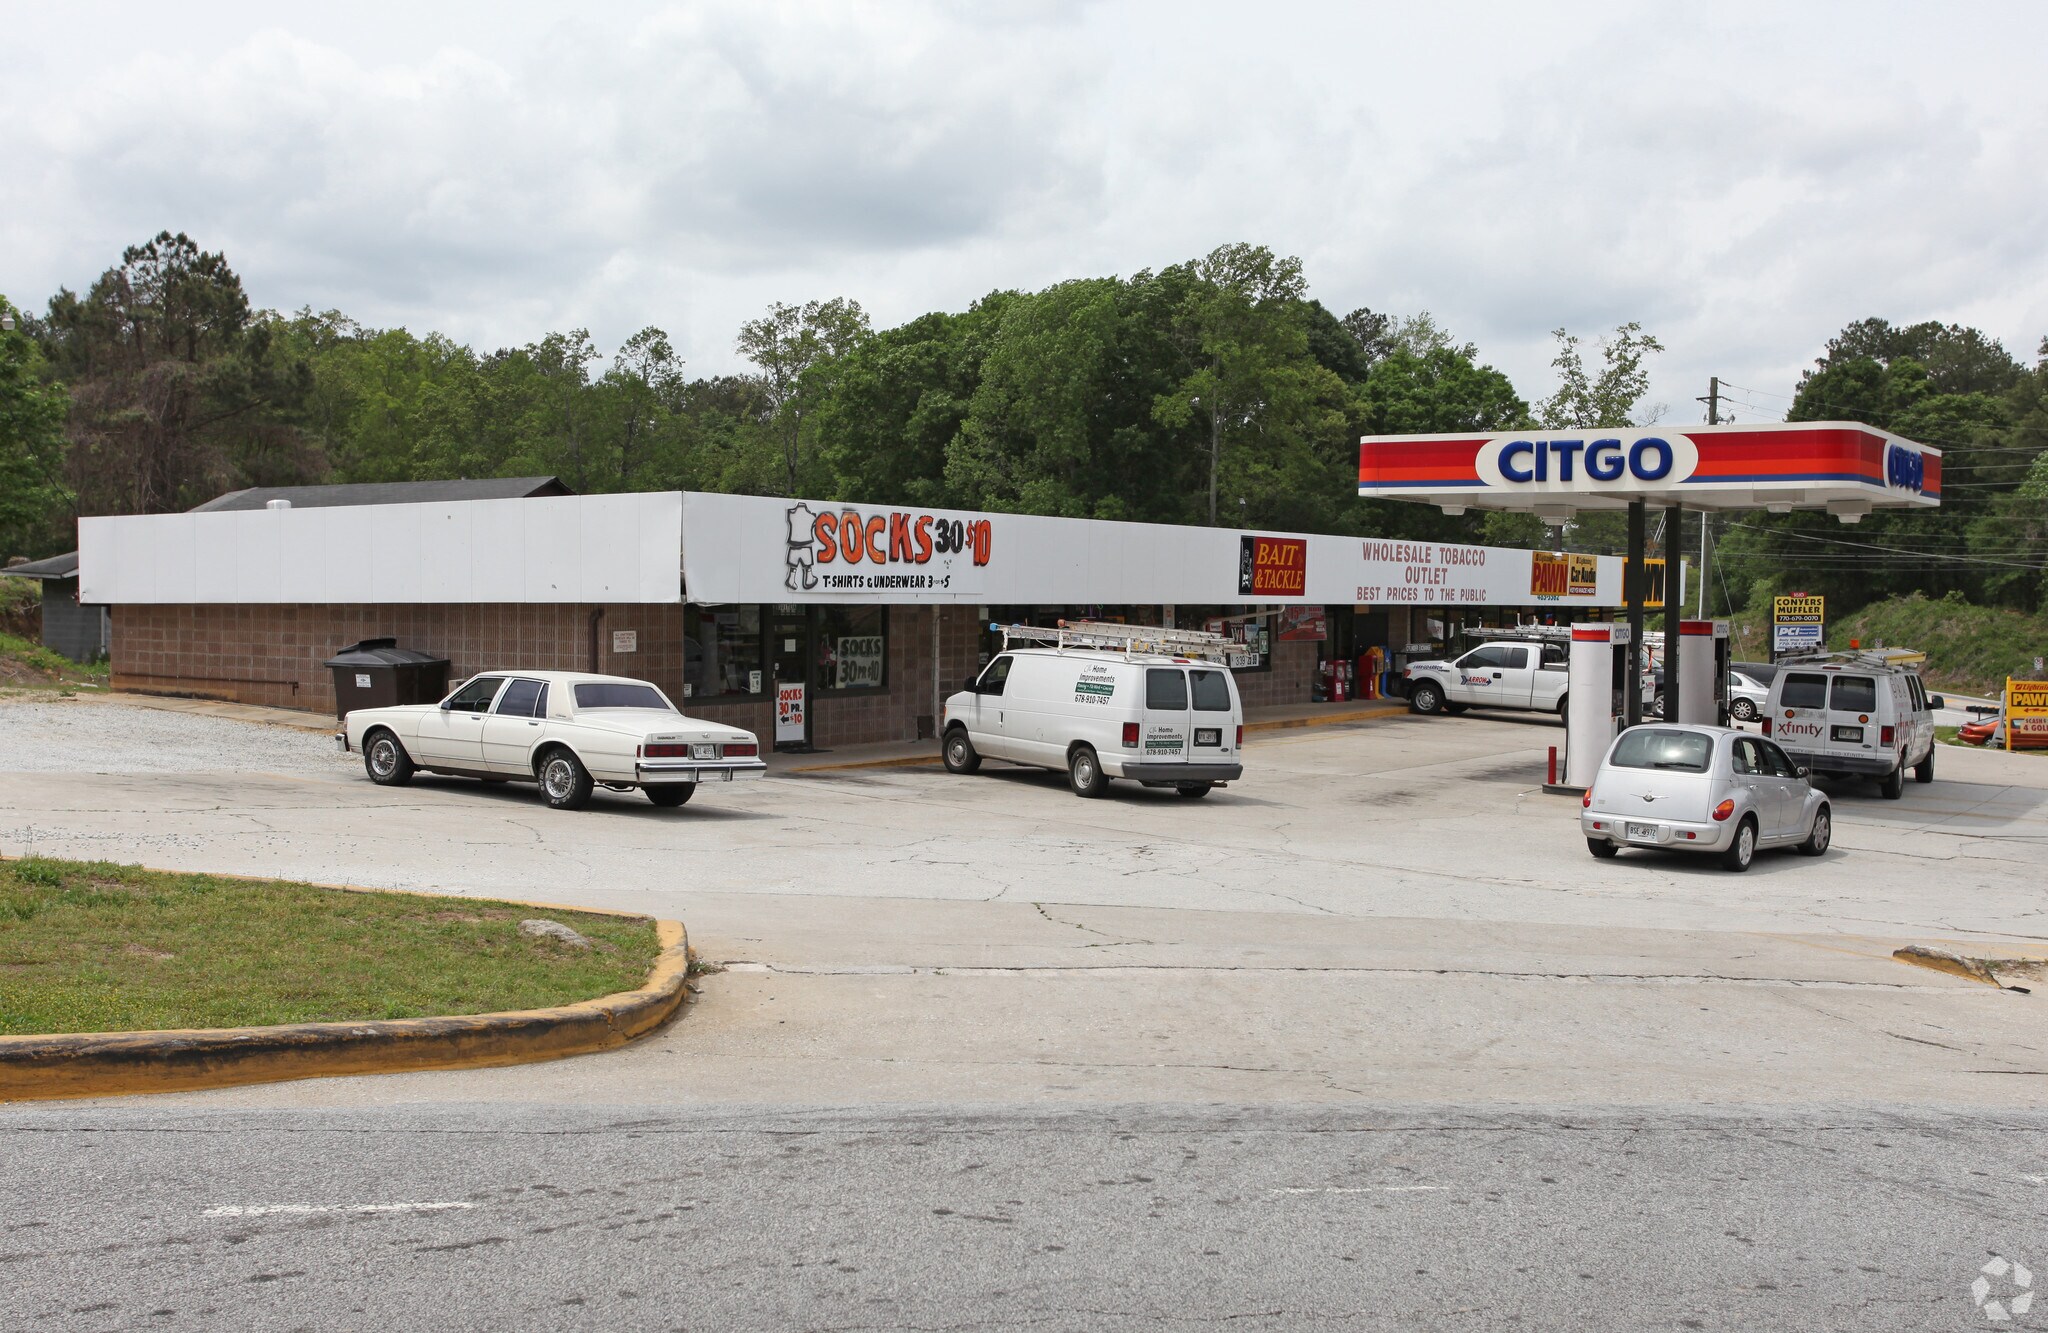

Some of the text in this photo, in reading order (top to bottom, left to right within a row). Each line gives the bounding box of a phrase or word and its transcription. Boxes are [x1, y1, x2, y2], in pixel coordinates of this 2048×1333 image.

[1498, 437, 1674, 483] CITGO
[815, 511, 992, 567] SOCKS 30 $10
[1256, 543, 1299, 566] BAIT
[1362, 542, 1486, 566] WHOLESALE TOBACCO
[822, 575, 864, 588] T-SHIRTS
[874, 575, 925, 588] UNDERWEAR
[1405, 566, 1448, 584] OUTLET
[1532, 562, 1568, 592] PAWN
[1570, 566, 1581, 583] Car
[1357, 586, 1487, 601] BEST PRICES TO THE PUBLIC
[1779, 627, 1800, 636] PCI
[840, 638, 881, 658] SOCKS
[840, 660, 858, 683] 30
[1092, 664, 1108, 674] Home
[1079, 673, 1115, 683] Improvements
[779, 688, 803, 701] SOCKS
[2013, 693, 2048, 706] PAW
[779, 702, 789, 715] 30
[790, 713, 803, 724] $10
[1778, 721, 1823, 738] xfinity
[1146, 748, 1182, 756] 678-910-7457
